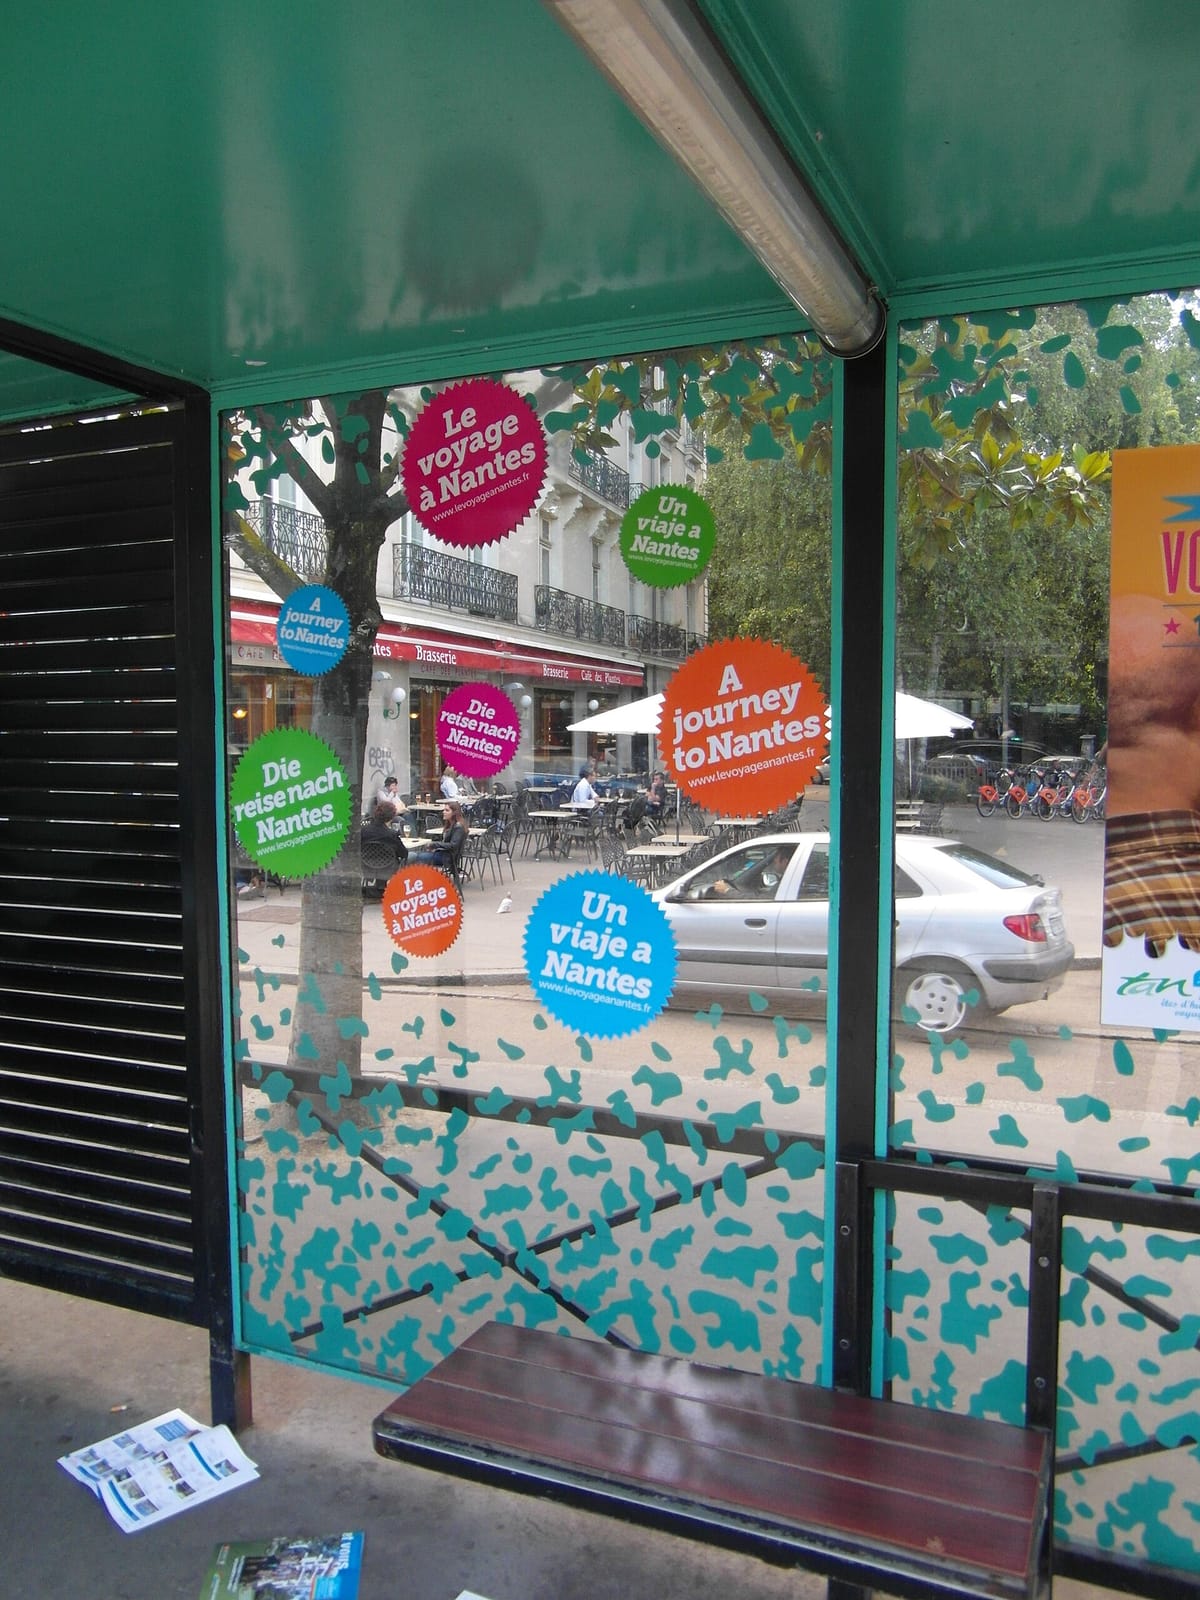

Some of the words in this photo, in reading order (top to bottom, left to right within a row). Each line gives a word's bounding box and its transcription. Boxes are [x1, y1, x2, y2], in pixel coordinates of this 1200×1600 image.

[442, 407, 477, 438] Le
[417, 414, 519, 476] voyage
[419, 485, 436, 512] à
[437, 442, 536, 503] Nantes
[432, 472, 530, 522] www.levoyageanantes.fr
[658, 496, 687, 516] Un
[638, 515, 686, 539] viaje
[688, 525, 701, 539] a
[629, 534, 699, 560] Nantes
[283, 608, 344, 633] journey
[309, 598, 321, 612] A
[280, 626, 294, 640] to
[294, 627, 345, 649] Nantes
[415, 645, 457, 665] Brasserie
[542, 664, 568, 679] Brasserie
[718, 664, 743, 696] A
[467, 699, 496, 719] Die
[672, 682, 802, 745] journey
[440, 711, 478, 731] reise
[477, 721, 517, 742] nach
[446, 728, 502, 756] Nantes
[672, 747, 705, 772] to
[706, 715, 821, 765] Nantes
[262, 757, 301, 788] Die
[687, 747, 815, 788] www.levoyageanantes.fr
[234, 792, 286, 822] reise
[287, 767, 344, 804] nach
[256, 804, 334, 844] Nantes
[256, 822, 343, 856] www.levoyageanantes.fr
[390, 887, 447, 915] voyage
[404, 879, 423, 895] Le
[392, 920, 402, 935] à
[402, 904, 457, 931] Nantes
[581, 890, 628, 926] Un
[550, 921, 628, 960] viaje
[631, 941, 652, 964] a
[540, 949, 652, 999] Nantes
[1116, 971, 1192, 997] tan
[538, 980, 652, 1013] www.levoyageanantes.fr
